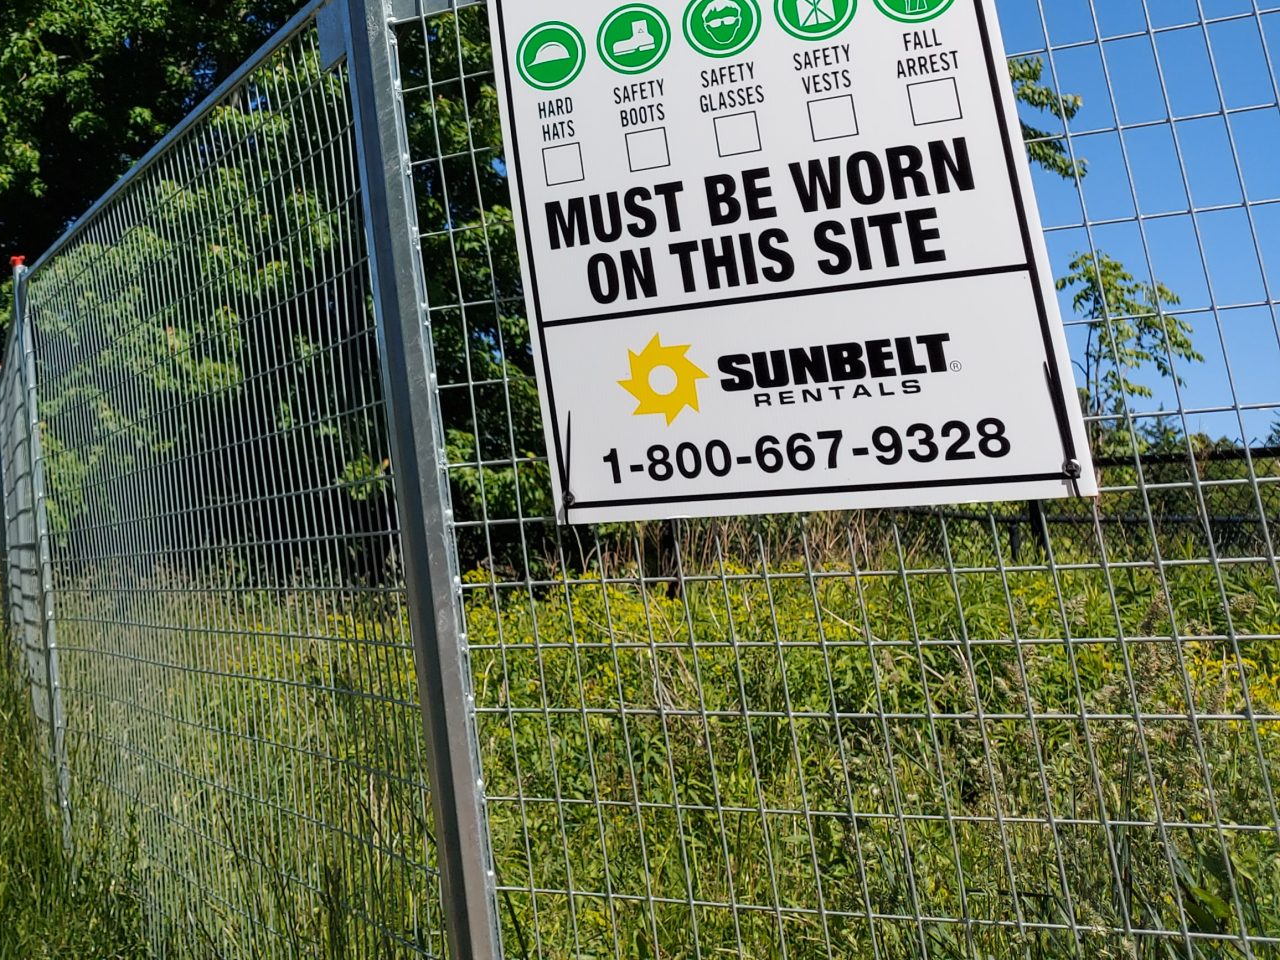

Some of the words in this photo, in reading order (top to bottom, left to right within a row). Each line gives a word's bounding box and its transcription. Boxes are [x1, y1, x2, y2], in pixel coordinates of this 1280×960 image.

[903, 29, 942, 51] FALL
[793, 44, 849, 71] SAFETY
[898, 51, 958, 78] ARREST
[701, 62, 753, 88] SAFETY
[802, 70, 851, 94] VESTS
[614, 79, 663, 104] SAFETY
[700, 85, 764, 113] GLASSES
[538, 97, 573, 119] HARD
[620, 103, 664, 127] BOOTS
[542, 120, 574, 141] HATS
[545, 181, 683, 250] MUST
[704, 167, 777, 226] BE
[788, 137, 975, 213] WORN
[587, 247, 657, 304] ON
[668, 228, 794, 293] THIS
[814, 207, 946, 275] SITE
[754, 380, 921, 407] RENTALS
[603, 418, 1010, 484] 1-800-667-9328
